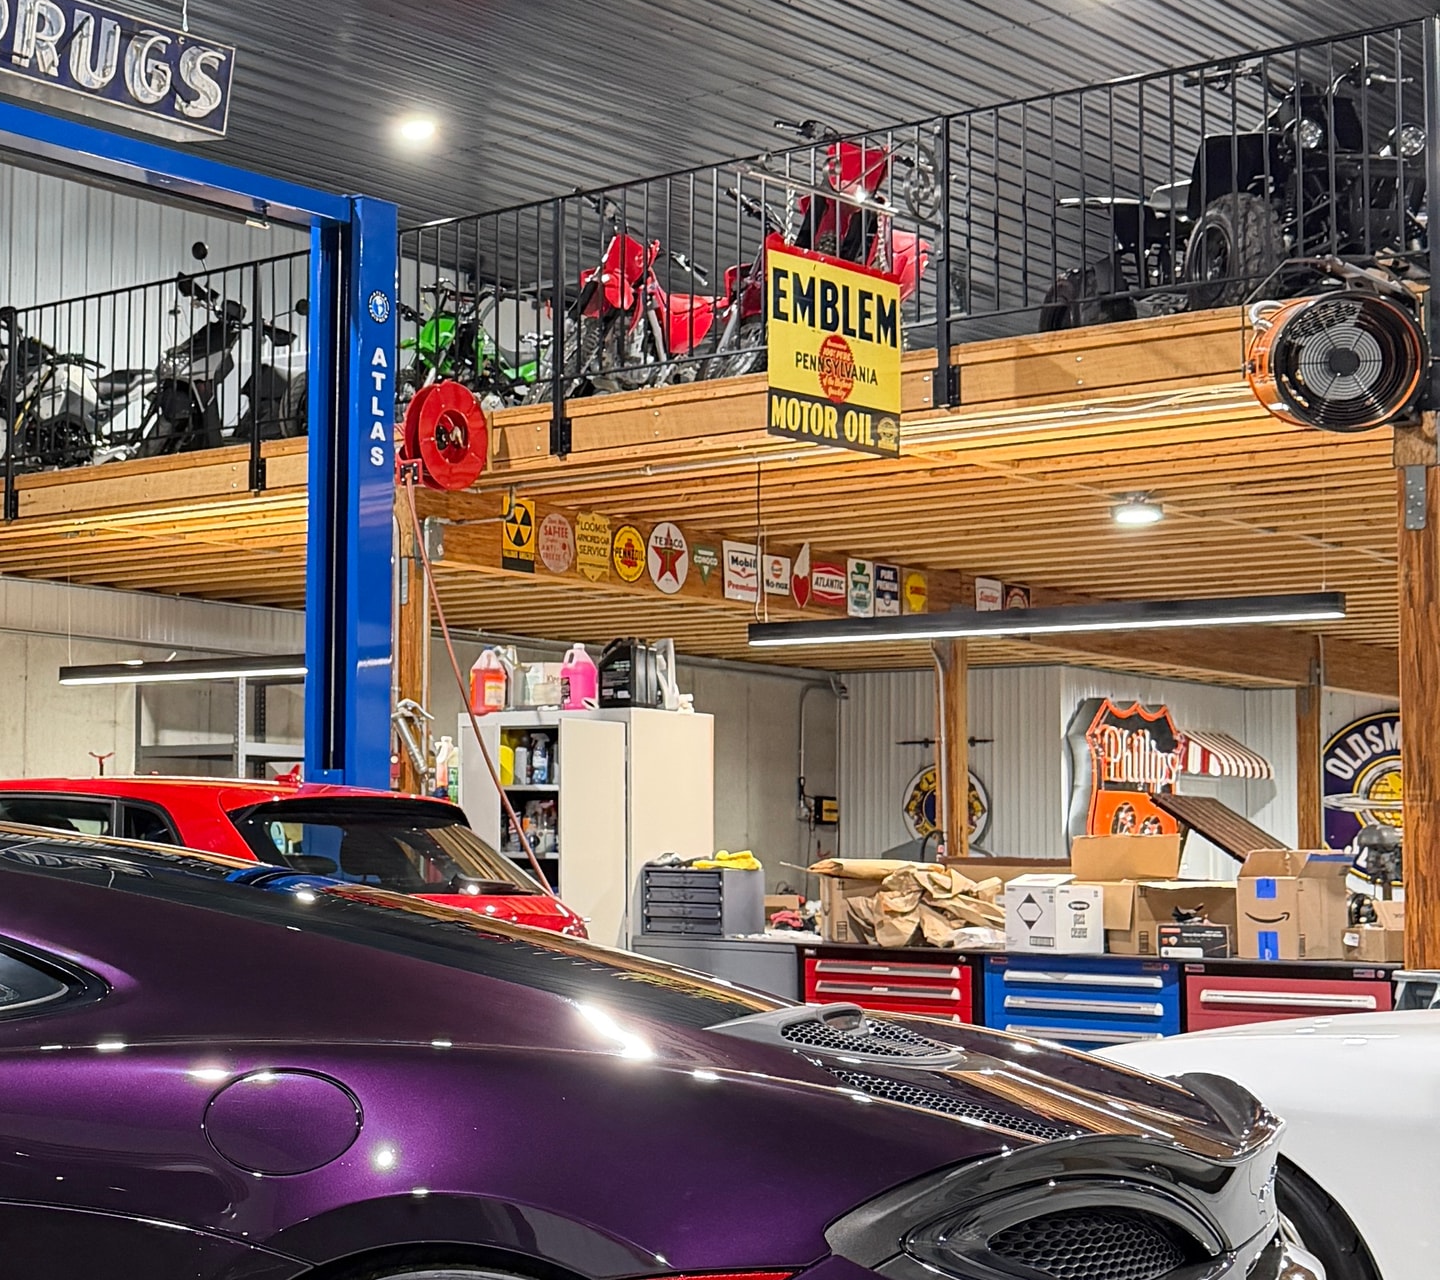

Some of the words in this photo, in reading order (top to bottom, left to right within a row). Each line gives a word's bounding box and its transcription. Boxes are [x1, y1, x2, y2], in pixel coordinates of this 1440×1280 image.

[772, 266, 898, 349] EMBLEM
[795, 351, 878, 386] PENNSYLVANIA
[370, 347, 388, 467] ATLAS
[771, 394, 838, 440] MOTOR
[844, 409, 875, 447] OIL
[580, 521, 607, 534] LOOMIS
[654, 535, 684, 549] TEXACO
[579, 544, 608, 558] SERVICE
[813, 576, 845, 591] ATLANTIC
[1096, 723, 1179, 795] Phillips
